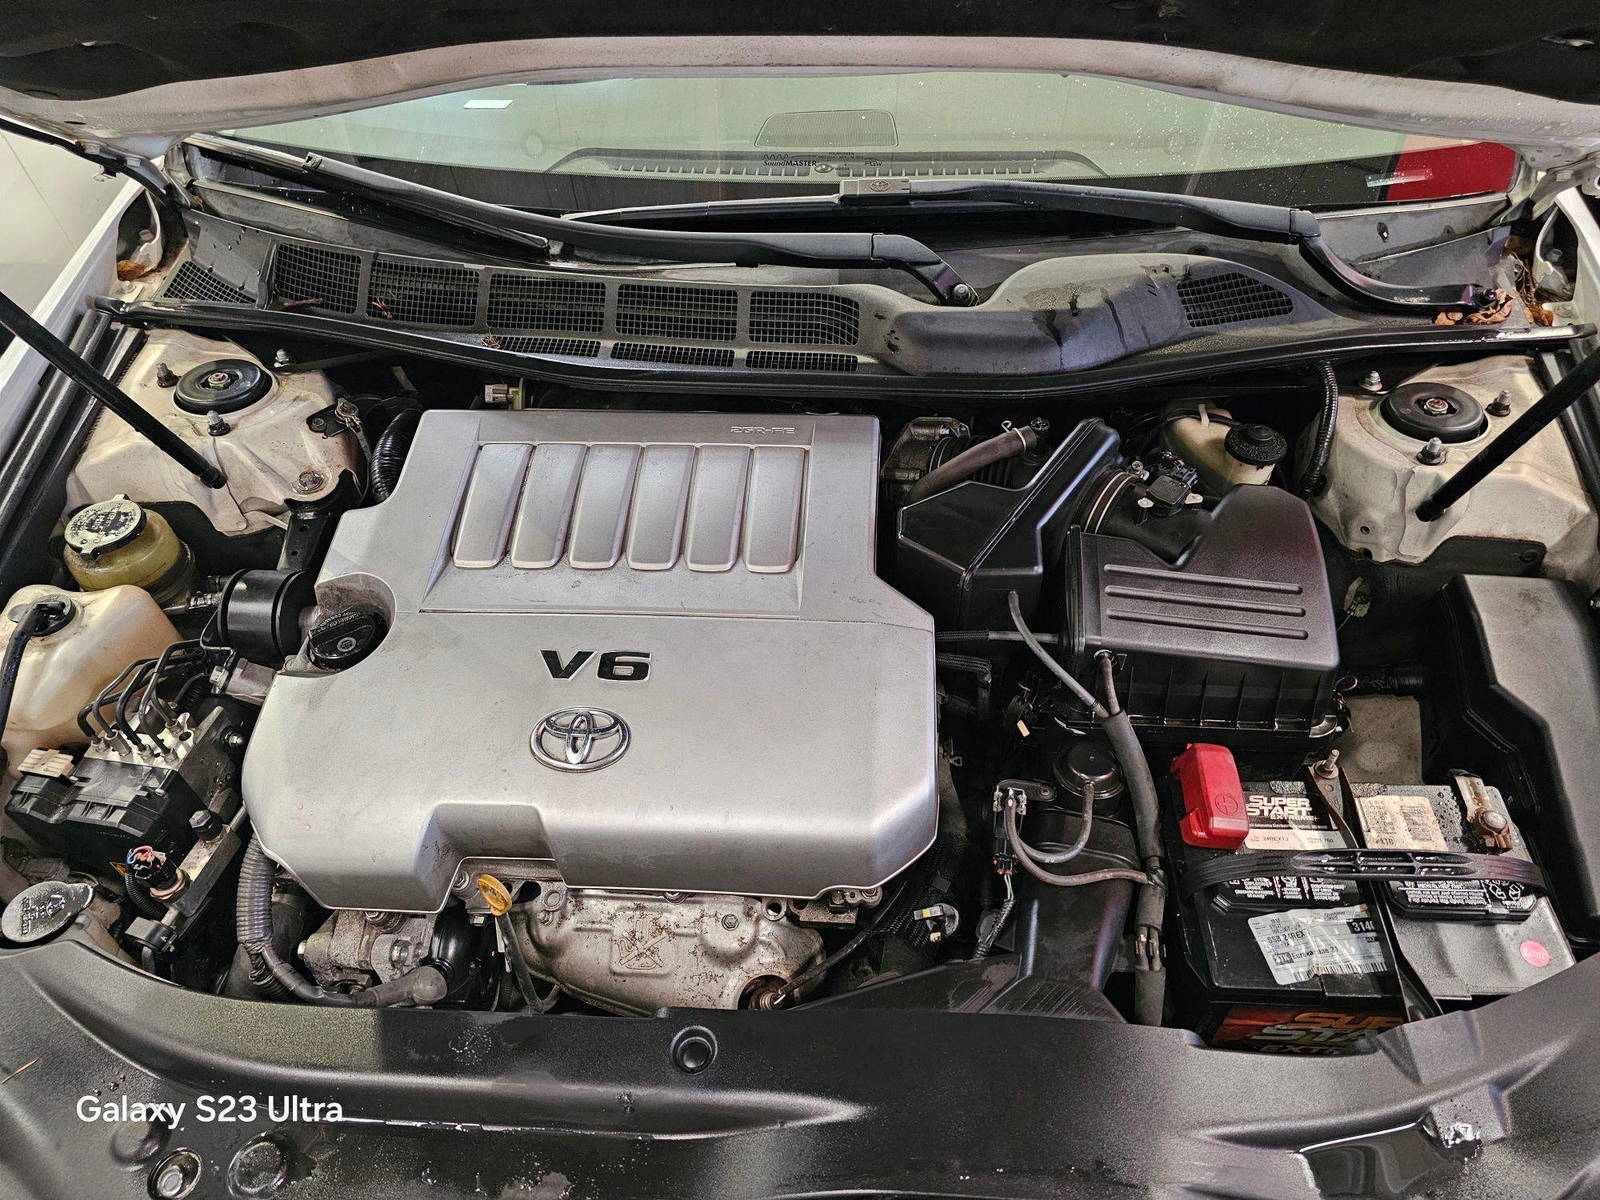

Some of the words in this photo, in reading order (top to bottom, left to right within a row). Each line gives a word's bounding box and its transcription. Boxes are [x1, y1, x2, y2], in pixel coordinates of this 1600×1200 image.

[539, 649, 652, 681] V6
[1248, 794, 1311, 807] SUPER
[1246, 803, 1313, 817] START
[1288, 1011, 1404, 1030] SUP
